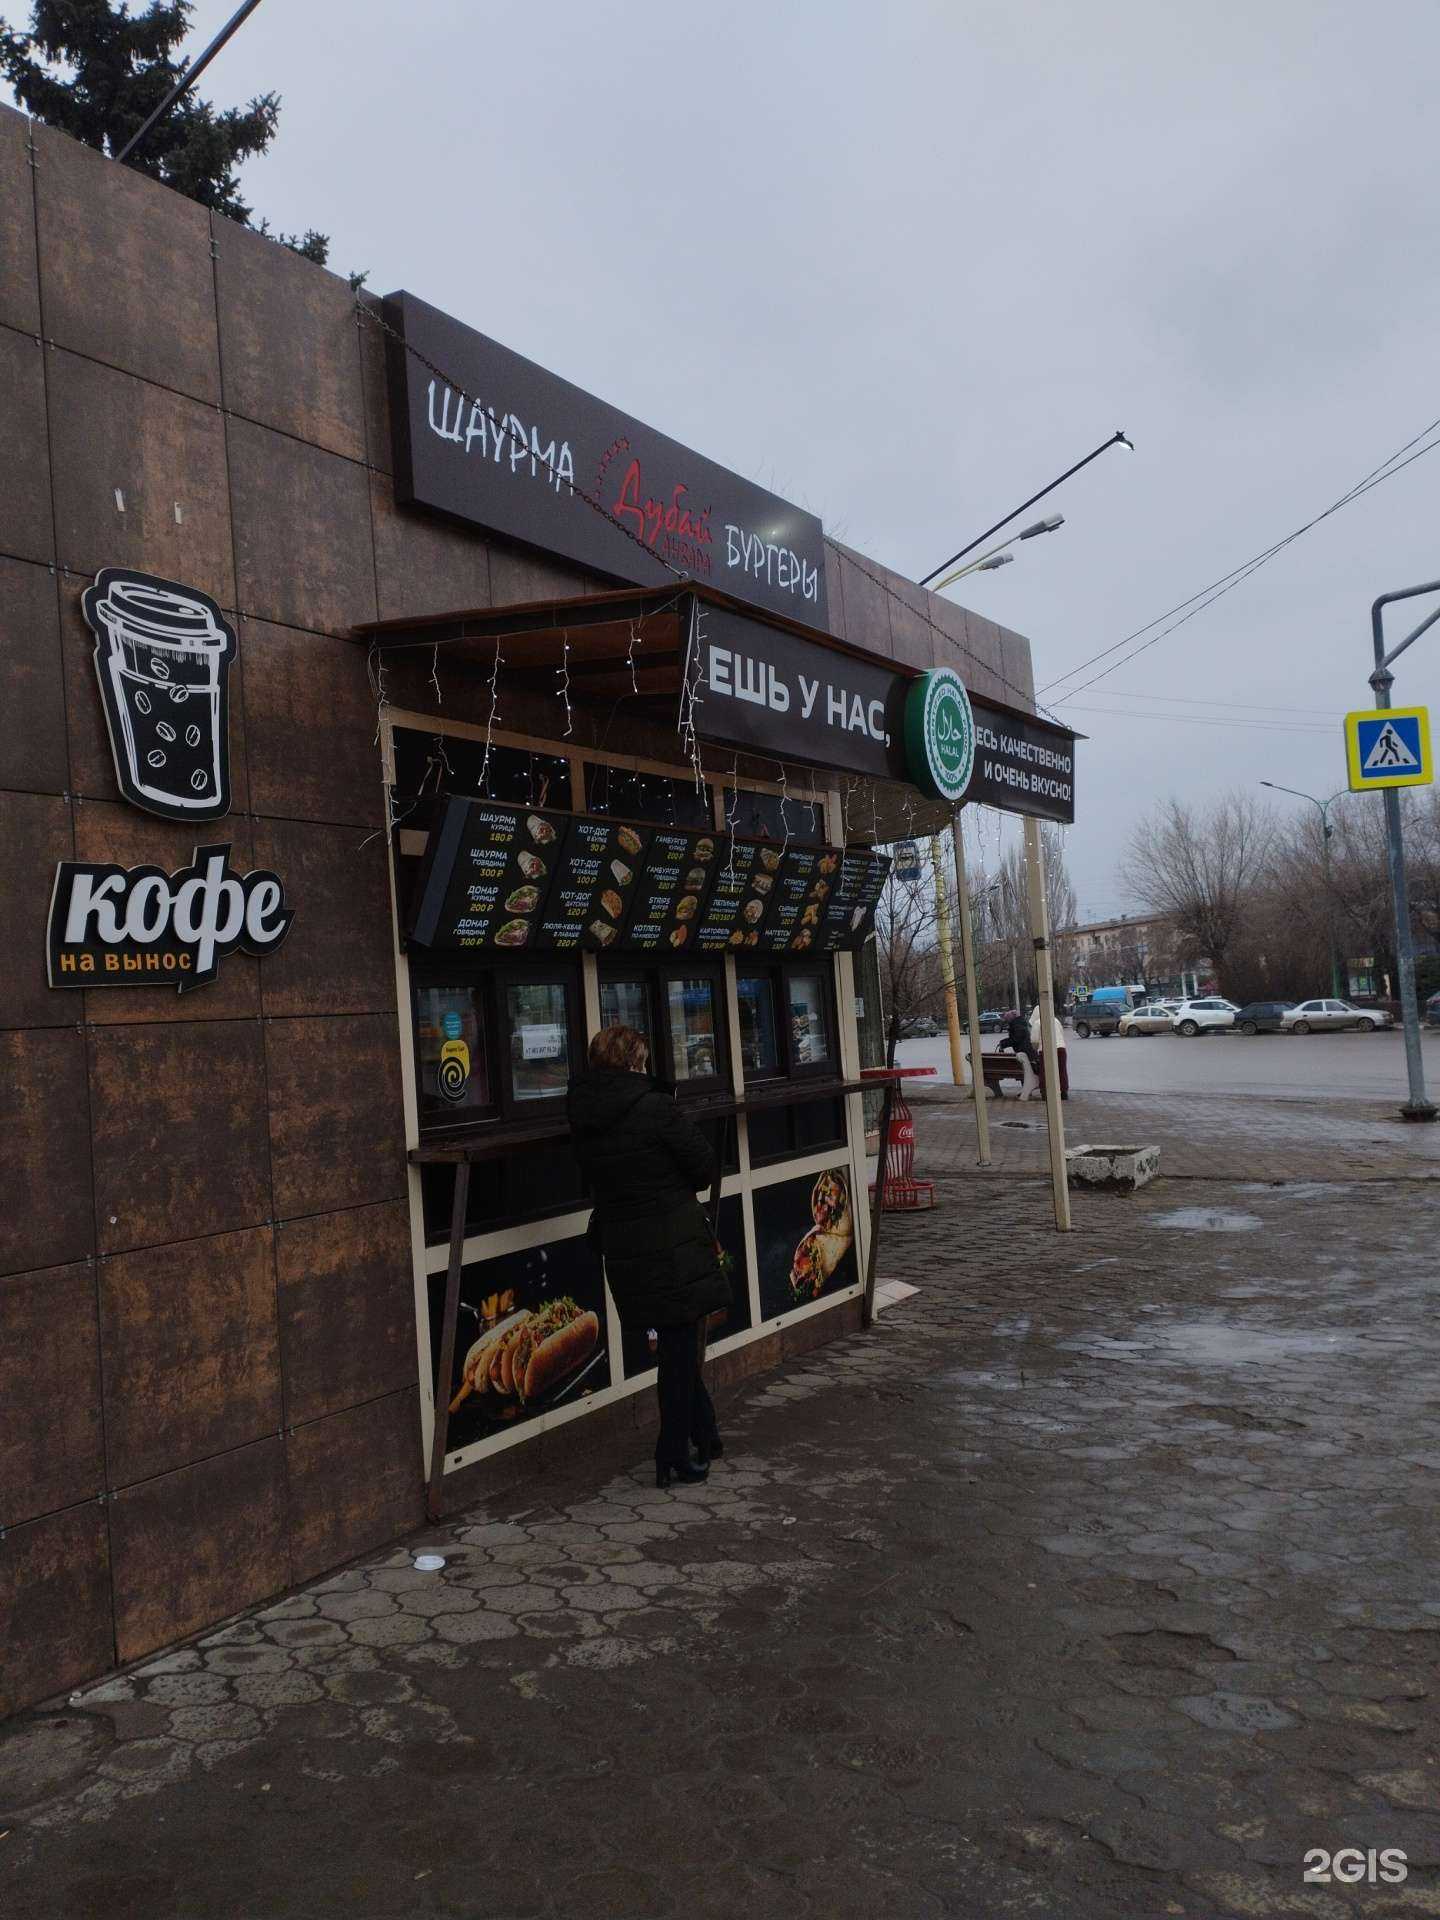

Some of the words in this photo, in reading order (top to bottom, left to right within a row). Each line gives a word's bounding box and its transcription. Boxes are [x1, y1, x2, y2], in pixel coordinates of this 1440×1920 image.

[428, 379, 574, 497] ШАУРМА
[612, 459, 713, 545] Дубай
[725, 524, 818, 604] БУРГЕРЫ
[709, 644, 790, 713] ЕШЬ
[798, 674, 820, 719] У
[827, 684, 891, 748] НАС,
[976, 726, 998, 750] ЕСЬ
[1000, 734, 1072, 774] КАЧЕСТВЕННО
[984, 760, 993, 780] И
[994, 763, 1030, 790] ОЧЕНЬ
[1031, 774, 1072, 802] ВКУСНО!
[480, 812, 516, 825] ШАУРМА
[578, 825, 610, 836] ХОТ-ДОГ
[470, 848, 508, 860] ШАУРМА
[569, 858, 602, 868] ХОТ-ДОГ
[467, 885, 499, 895] ДОНАР
[560, 891, 592, 900] ХОТ-ДОГ
[64, 855, 287, 974] кофе
[458, 919, 489, 928] ДОНАР
[60, 953, 95, 972] на
[104, 952, 192, 971] вынос
